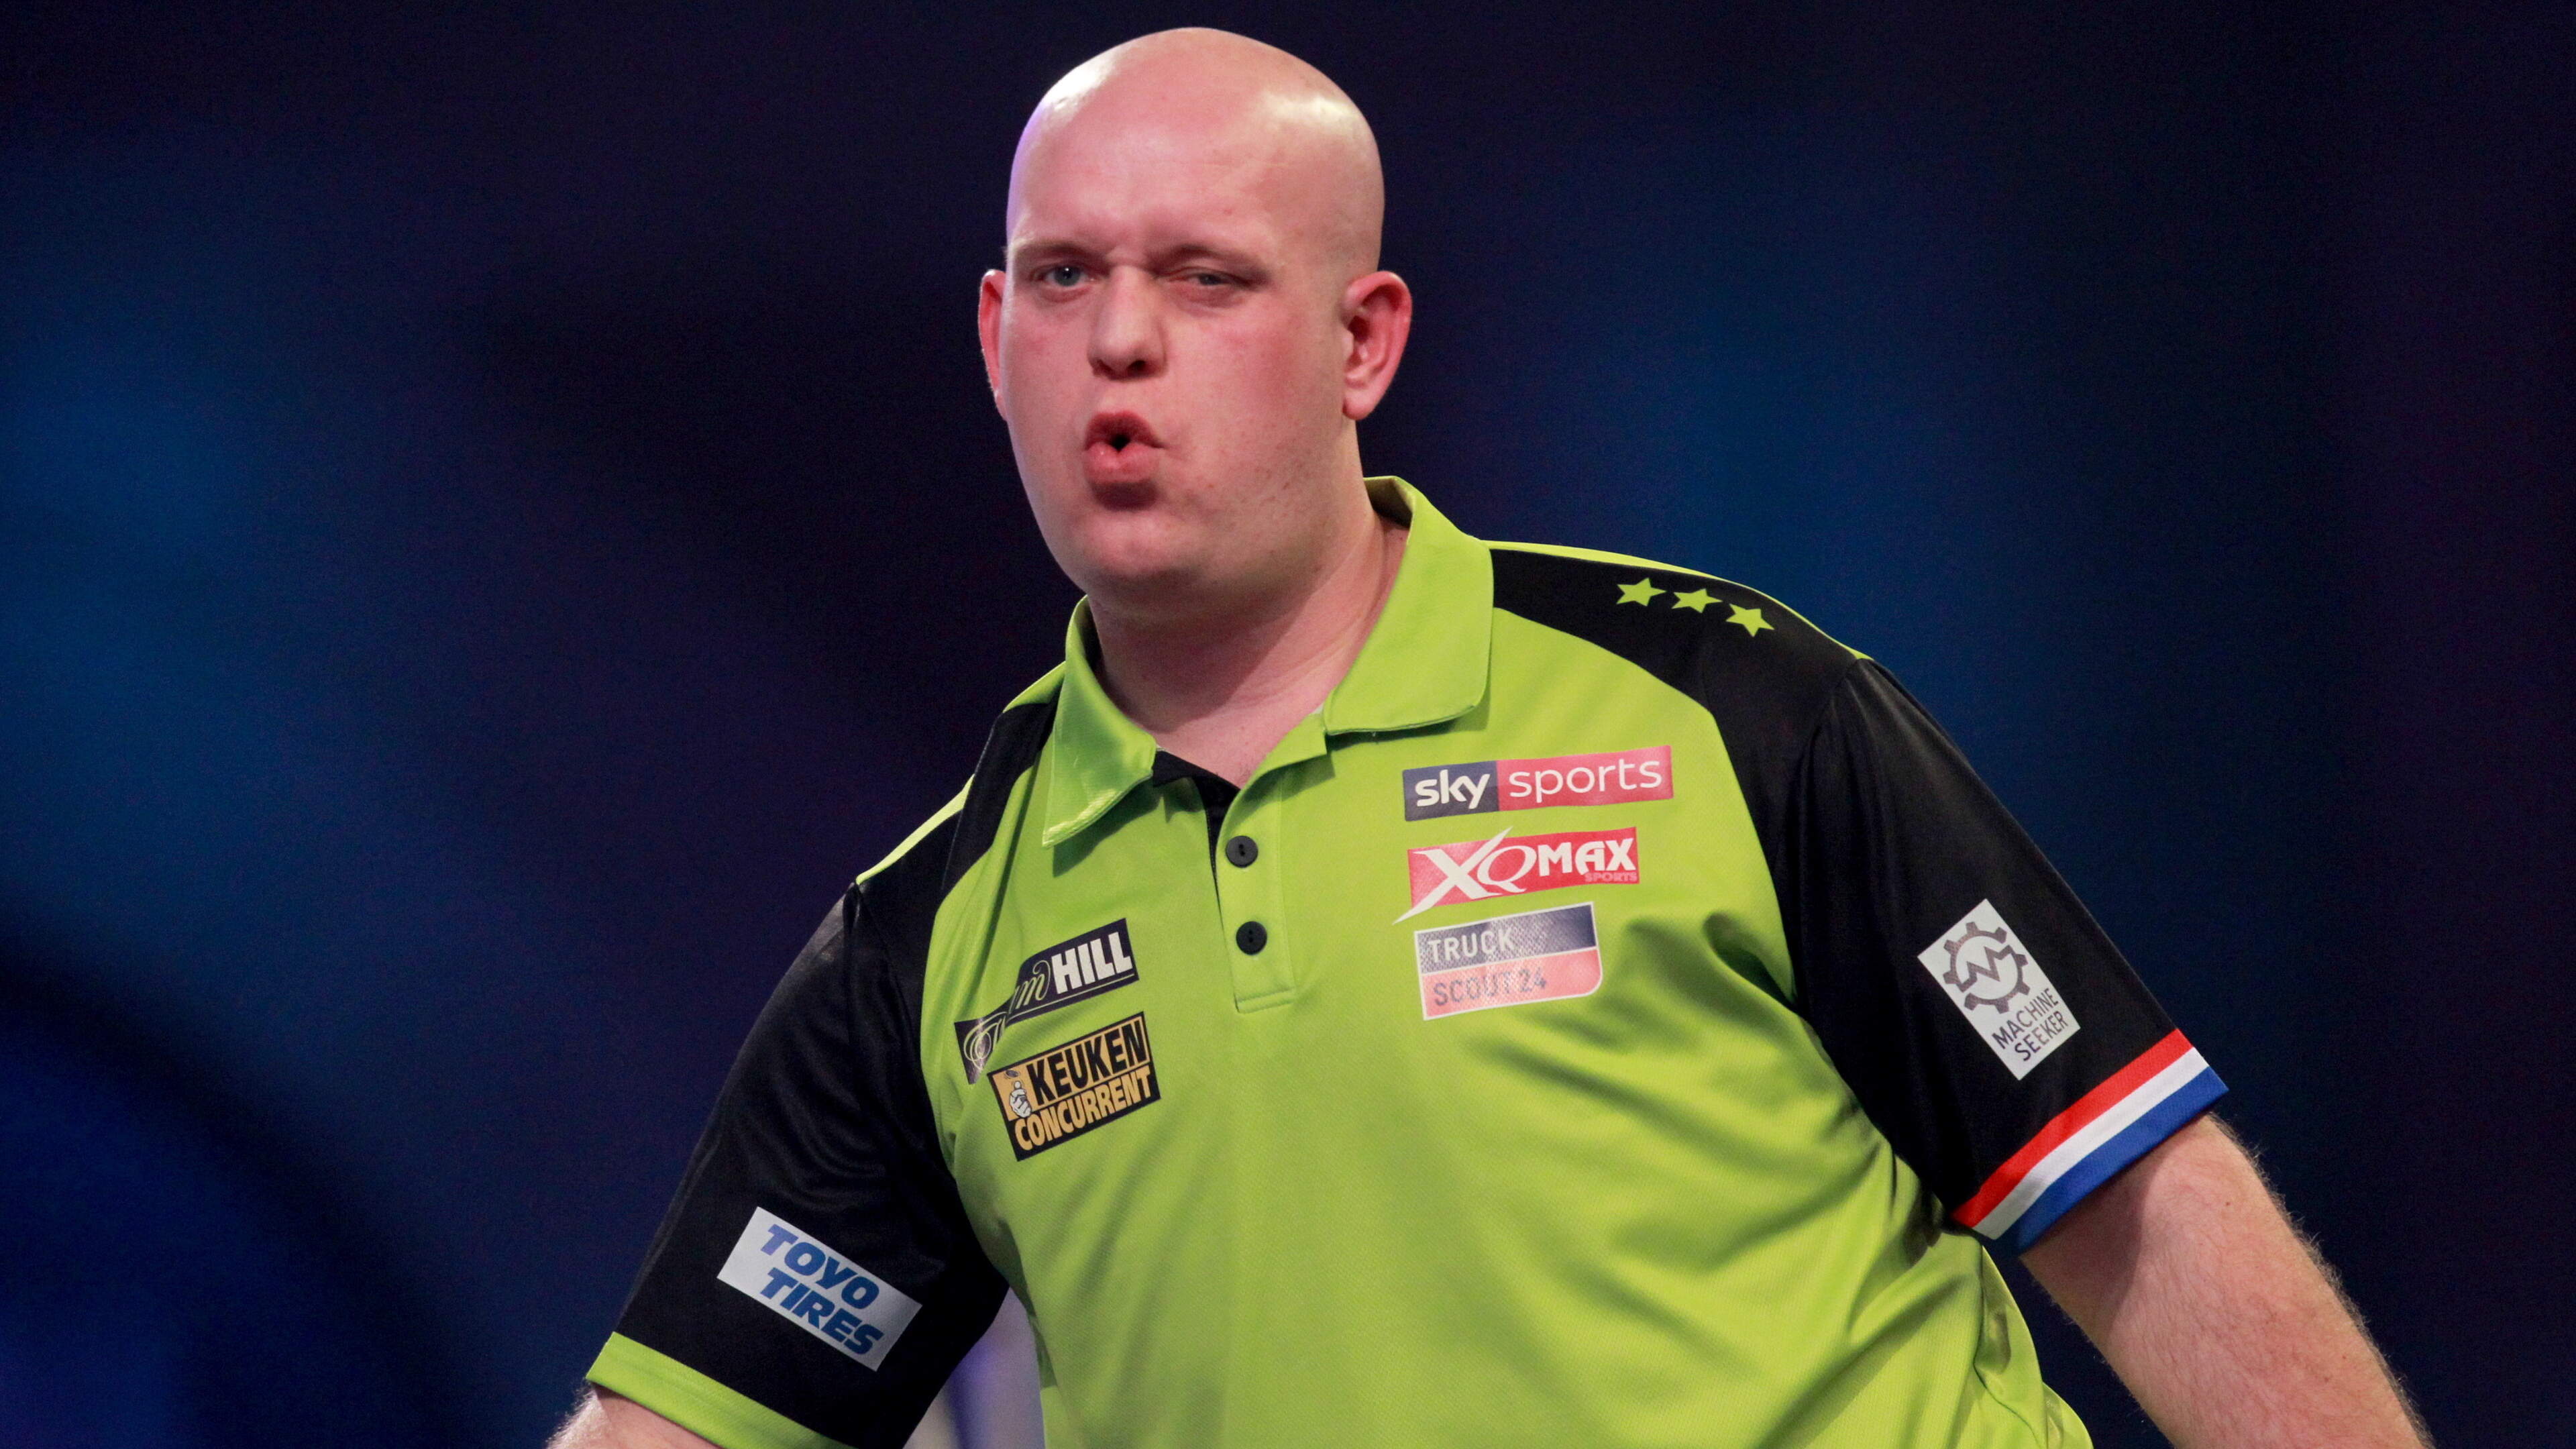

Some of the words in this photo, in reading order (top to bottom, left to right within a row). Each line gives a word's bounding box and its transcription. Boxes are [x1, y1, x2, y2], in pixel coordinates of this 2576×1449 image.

[1415, 769, 1491, 810] sky
[1509, 759, 1663, 804] sports
[1392, 826, 1637, 925] XQMAX
[1585, 871, 1638, 883] SPORTS
[1051, 931, 1134, 995] HILL
[1428, 928, 1515, 963] TRUCK
[1433, 967, 1547, 1007] SCOUT24
[1991, 987, 2059, 1050] MACHINE
[1026, 1019, 1147, 1106] KEUKEN
[2014, 1010, 2069, 1062] SEEKER
[1014, 1065, 1152, 1151] CONCURRENT
[760, 1224, 880, 1309] TOYO
[759, 1267, 885, 1355] TIRES
